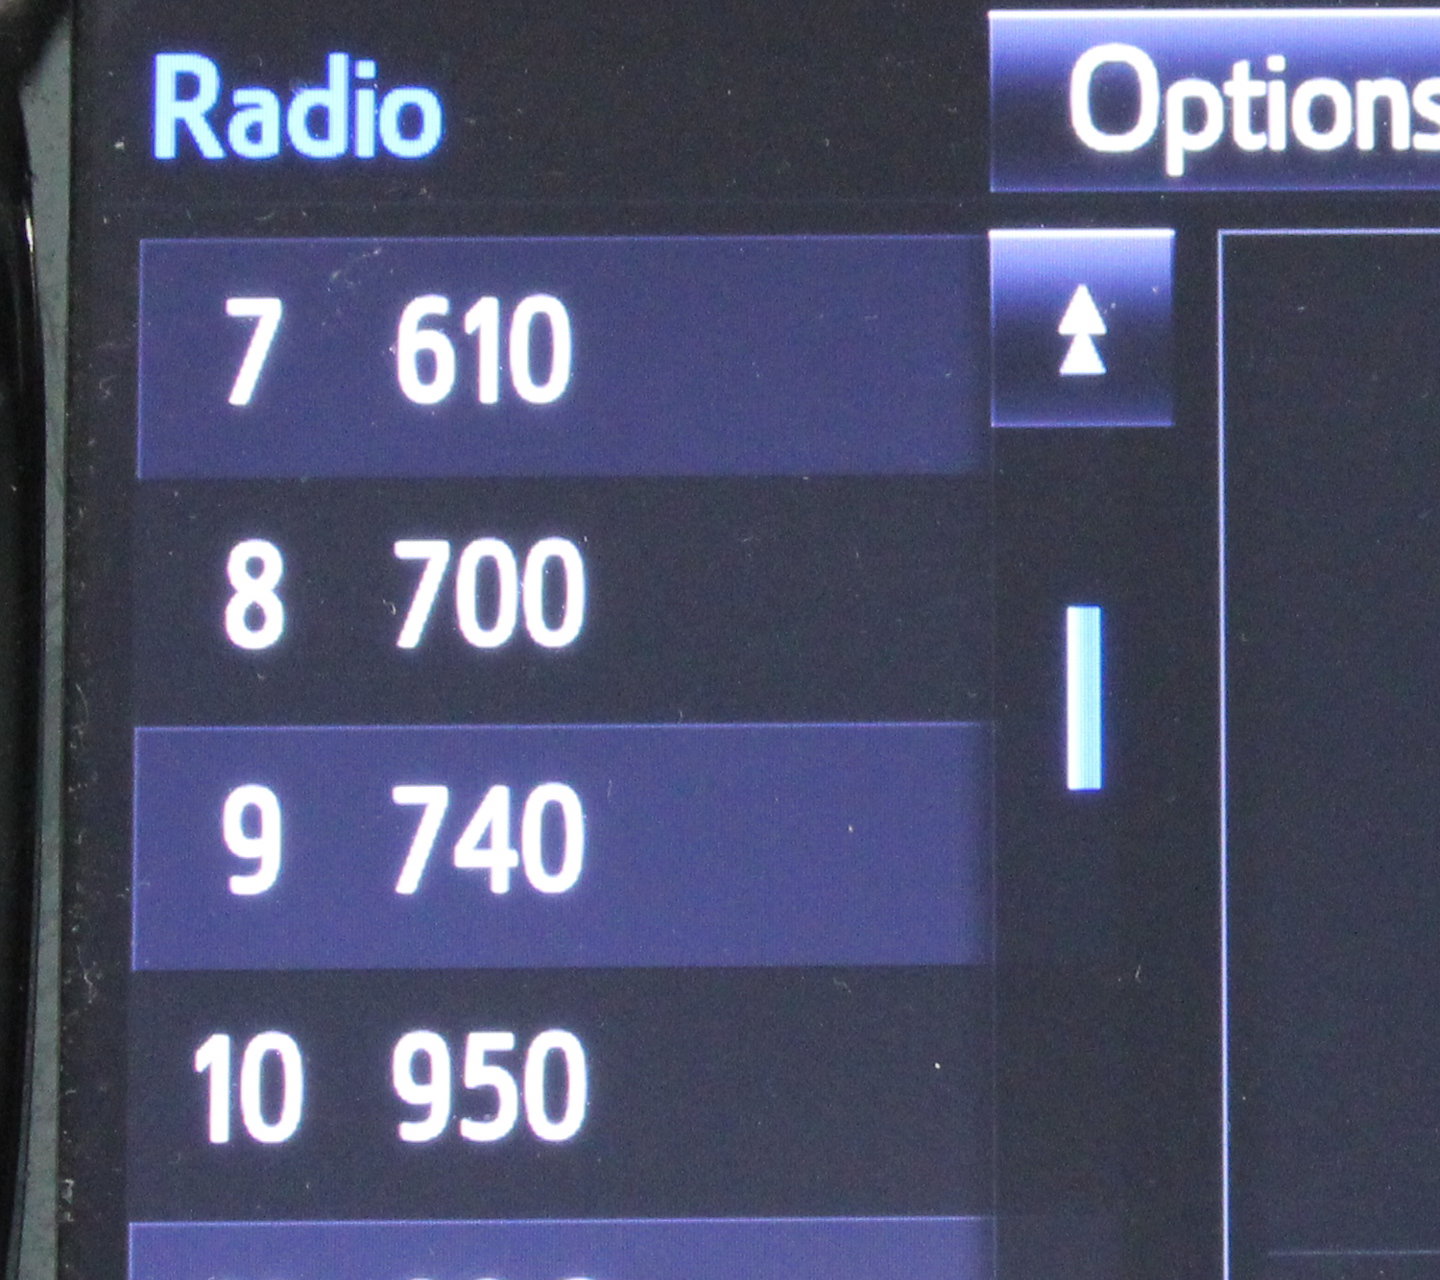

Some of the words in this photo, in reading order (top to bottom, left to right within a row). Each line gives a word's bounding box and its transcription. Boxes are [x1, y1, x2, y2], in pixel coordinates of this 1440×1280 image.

[153, 53, 443, 160] Radio
[224, 297, 284, 408] 7
[395, 294, 573, 407] 610
[223, 539, 286, 652] 8
[392, 537, 587, 650] 700
[221, 784, 284, 897] 9
[390, 782, 587, 896] 740
[195, 1031, 306, 1145] 10
[390, 1029, 589, 1144] 950
